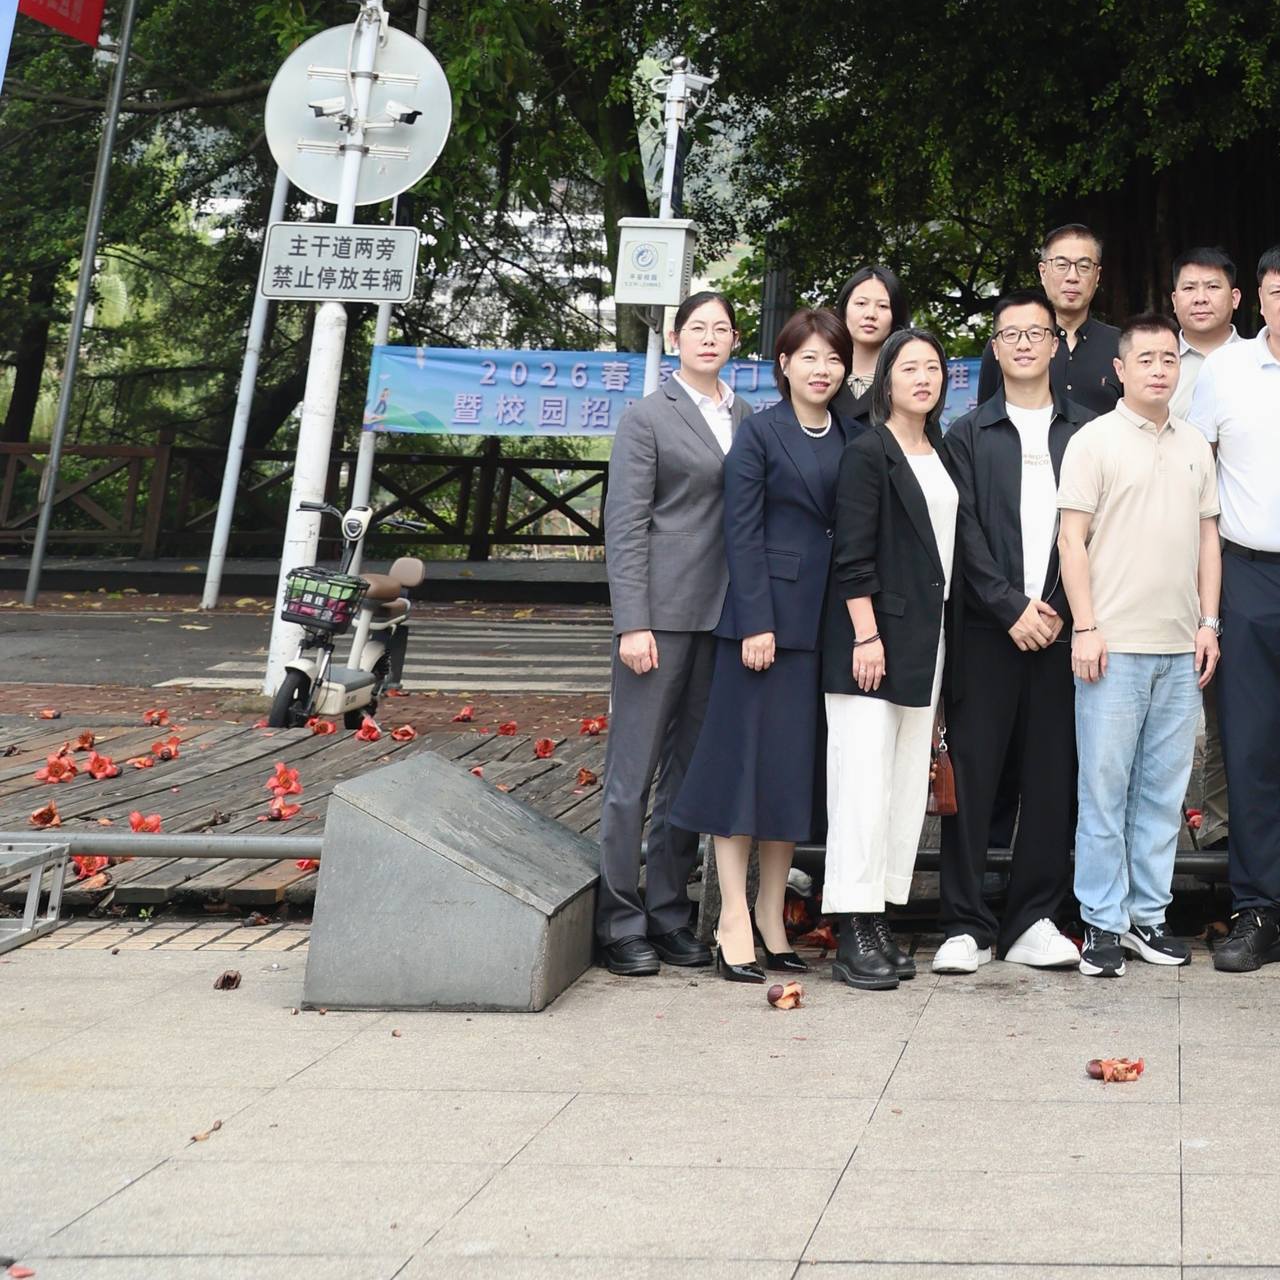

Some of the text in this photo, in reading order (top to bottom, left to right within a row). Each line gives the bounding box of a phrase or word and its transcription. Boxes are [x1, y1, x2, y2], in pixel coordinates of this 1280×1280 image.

[288, 234, 396, 261] 主干道两旁
[272, 265, 404, 292] 禁止停放车辆
[452, 393, 638, 428] 暨校园招
